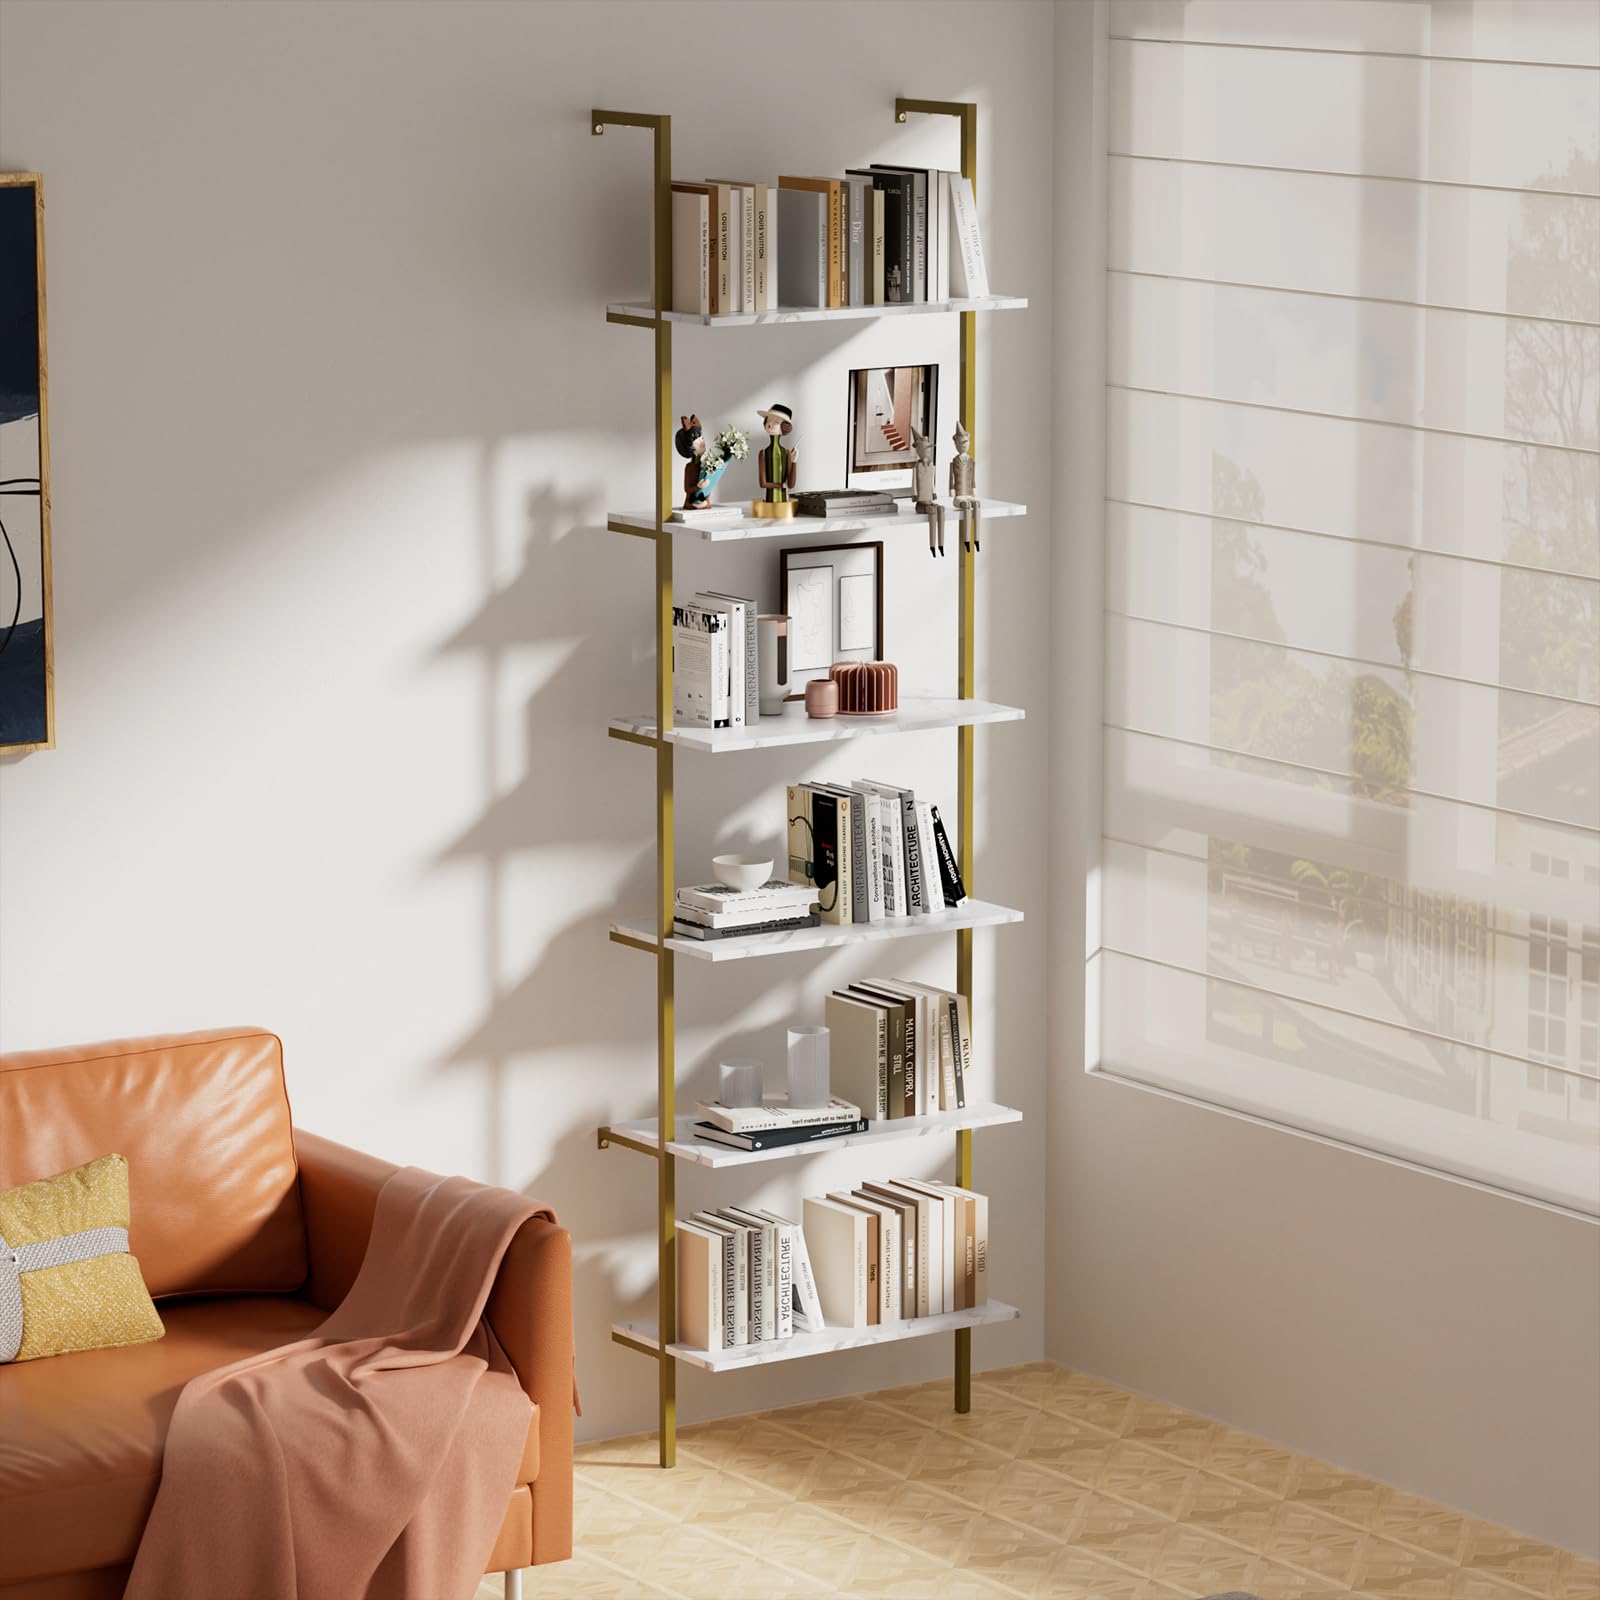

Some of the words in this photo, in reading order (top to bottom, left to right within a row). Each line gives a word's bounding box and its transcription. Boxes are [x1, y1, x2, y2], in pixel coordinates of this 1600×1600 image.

[745, 196, 753, 238] AFTERWORD
[746, 239, 753, 248] BY
[852, 221, 863, 244] Dior
[875, 236, 883, 256] West
[745, 250, 753, 275] DEEPAK
[745, 276, 753, 305] CHOPRA
[746, 609, 757, 708] INNENARCHITEKTUR
[870, 816, 878, 847] Architects
[853, 804, 866, 904] INNENARCHITEKTUR
[906, 825, 921, 907] ARCHITECTURE
[936, 832, 950, 860] FASHION
[945, 859, 960, 884] DESIGN
[872, 861, 880, 903] Conversations
[721, 925, 761, 935] Conversations
[774, 920, 802, 929] Architects
[878, 1018, 886, 1032] STAY
[905, 1018, 915, 1057] MALLIKA
[952, 1025, 960, 1055] GALLIANO
[878, 1033, 886, 1048] WITH
[878, 1049, 886, 1058] ME
[962, 1038, 971, 1070] PRADA
[893, 1055, 903, 1075] STILL
[905, 1061, 915, 1098] CHOPRA
